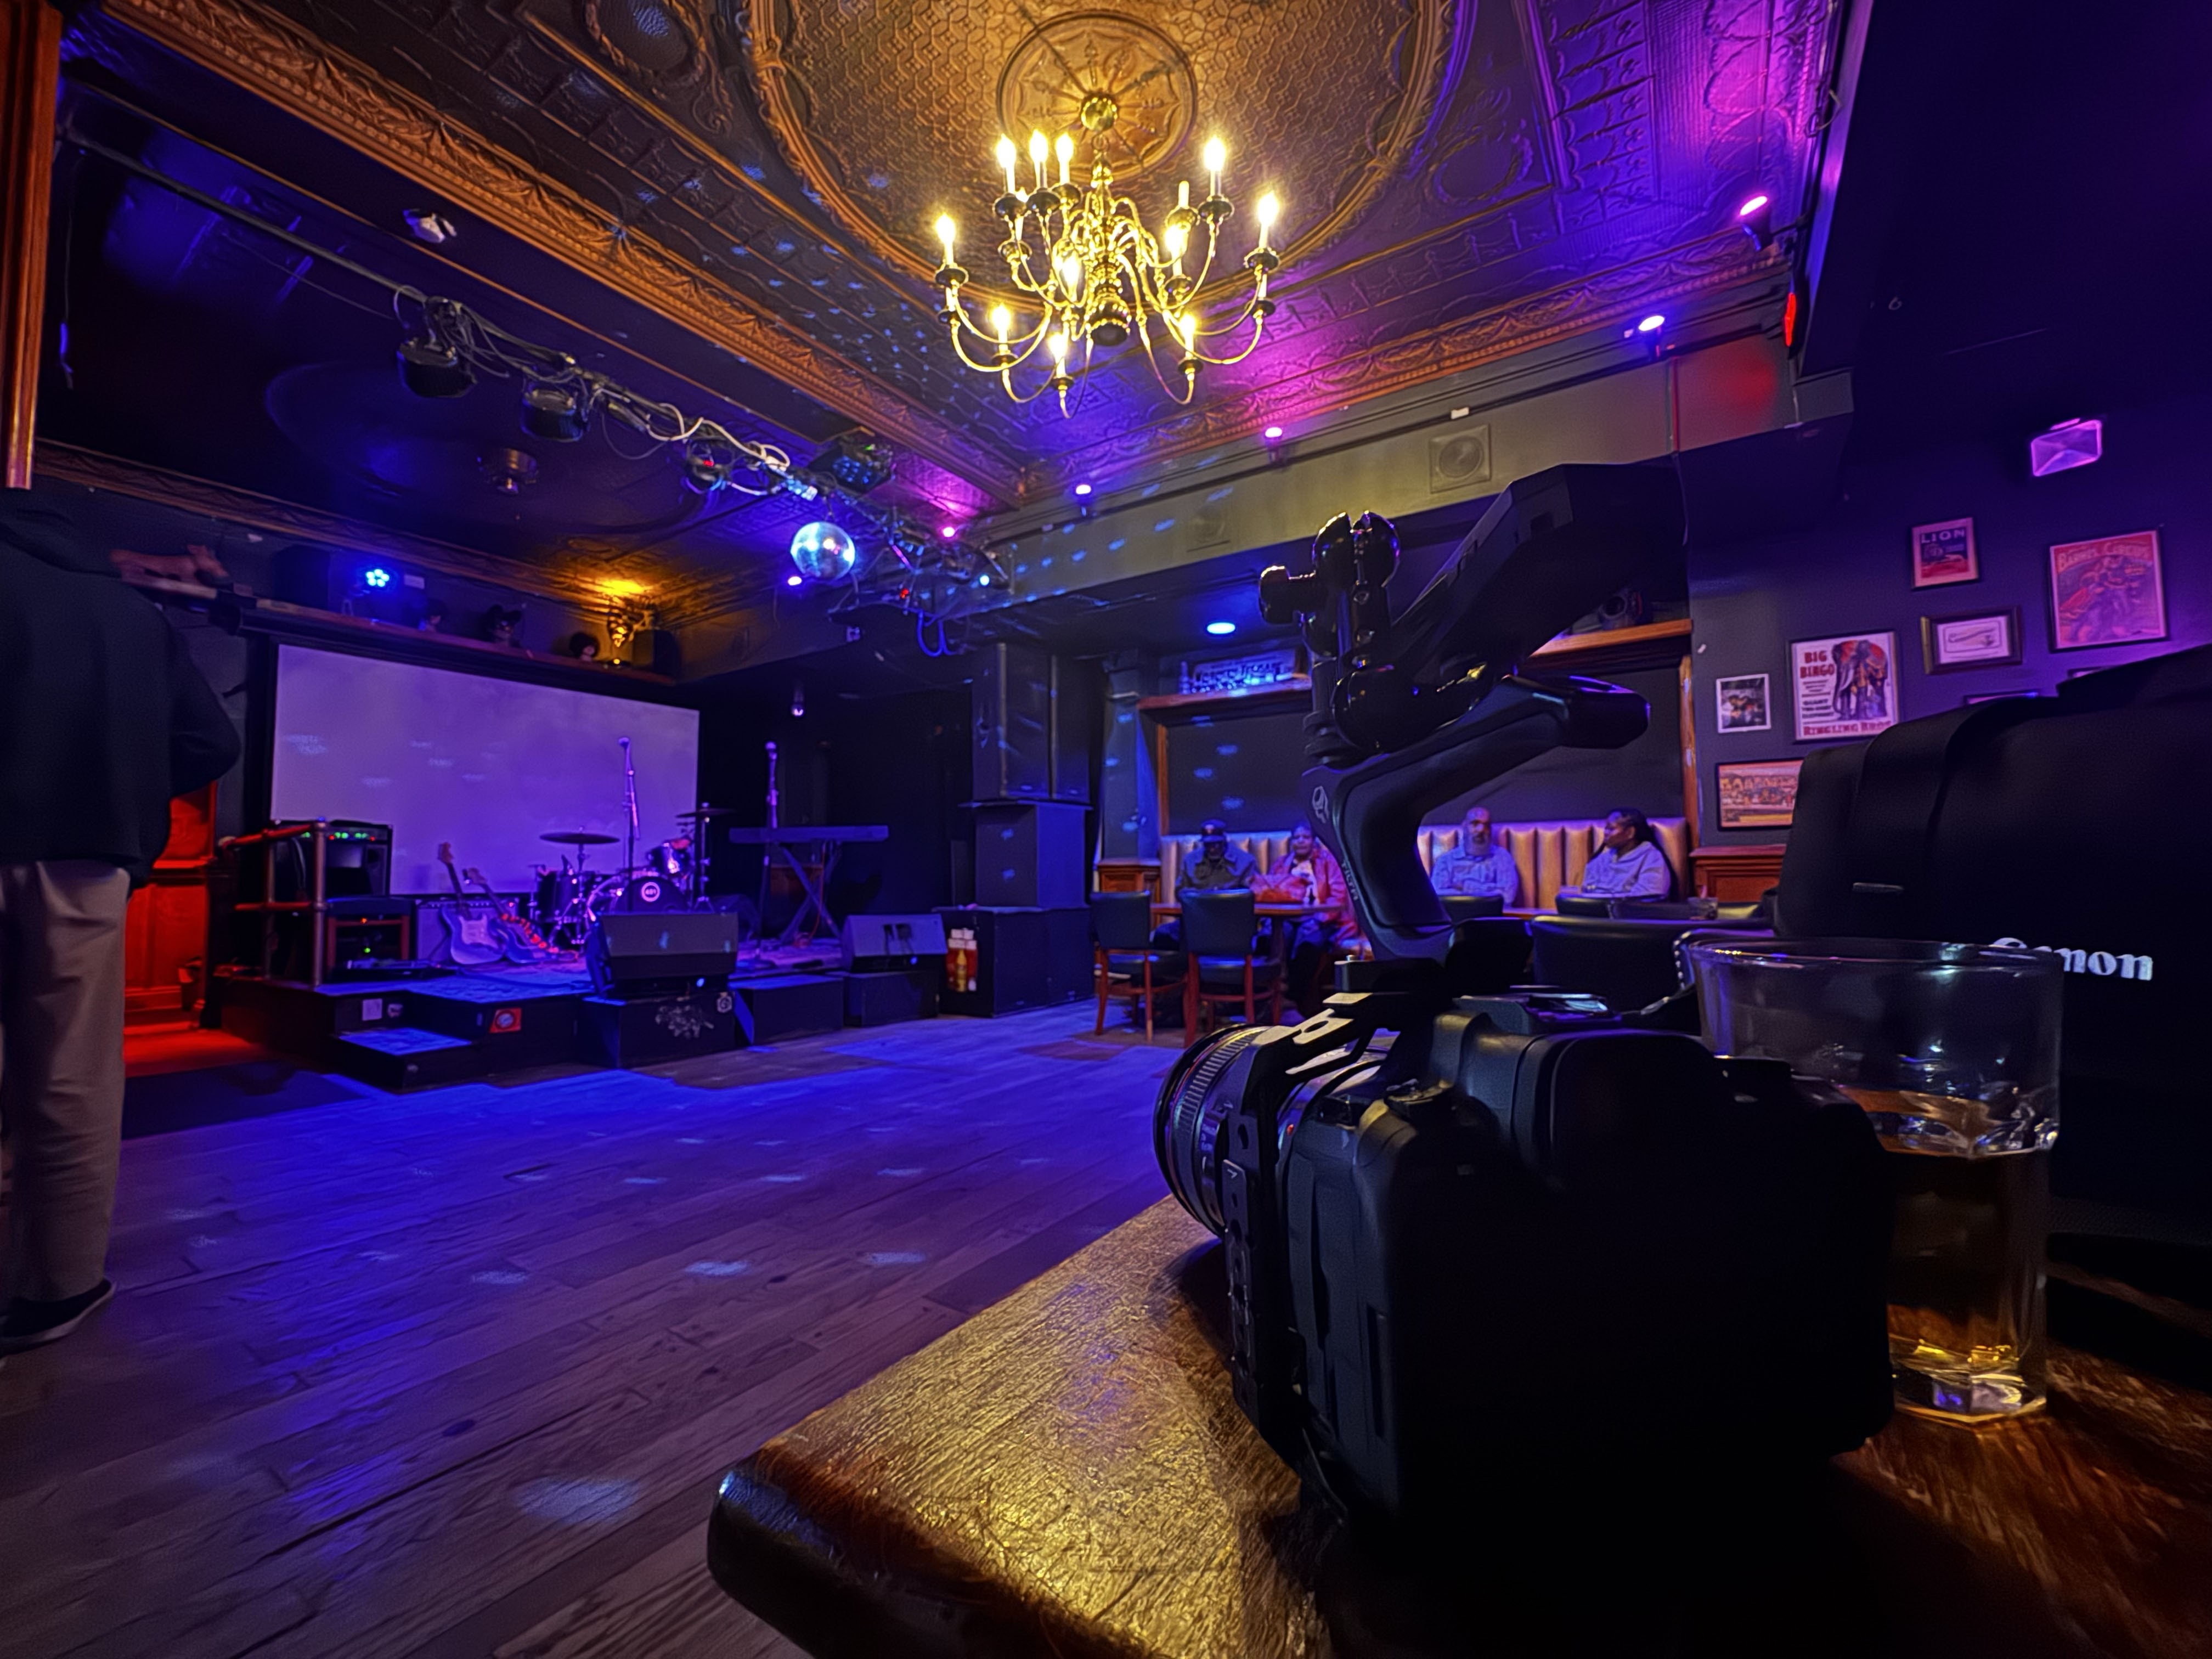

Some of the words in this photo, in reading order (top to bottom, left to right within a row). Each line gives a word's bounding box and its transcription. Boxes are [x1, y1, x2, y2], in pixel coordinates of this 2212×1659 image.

[1921, 529, 1965, 544] LION
[1804, 651, 1827, 664] BIG
[1799, 664, 1835, 679] BINGO
